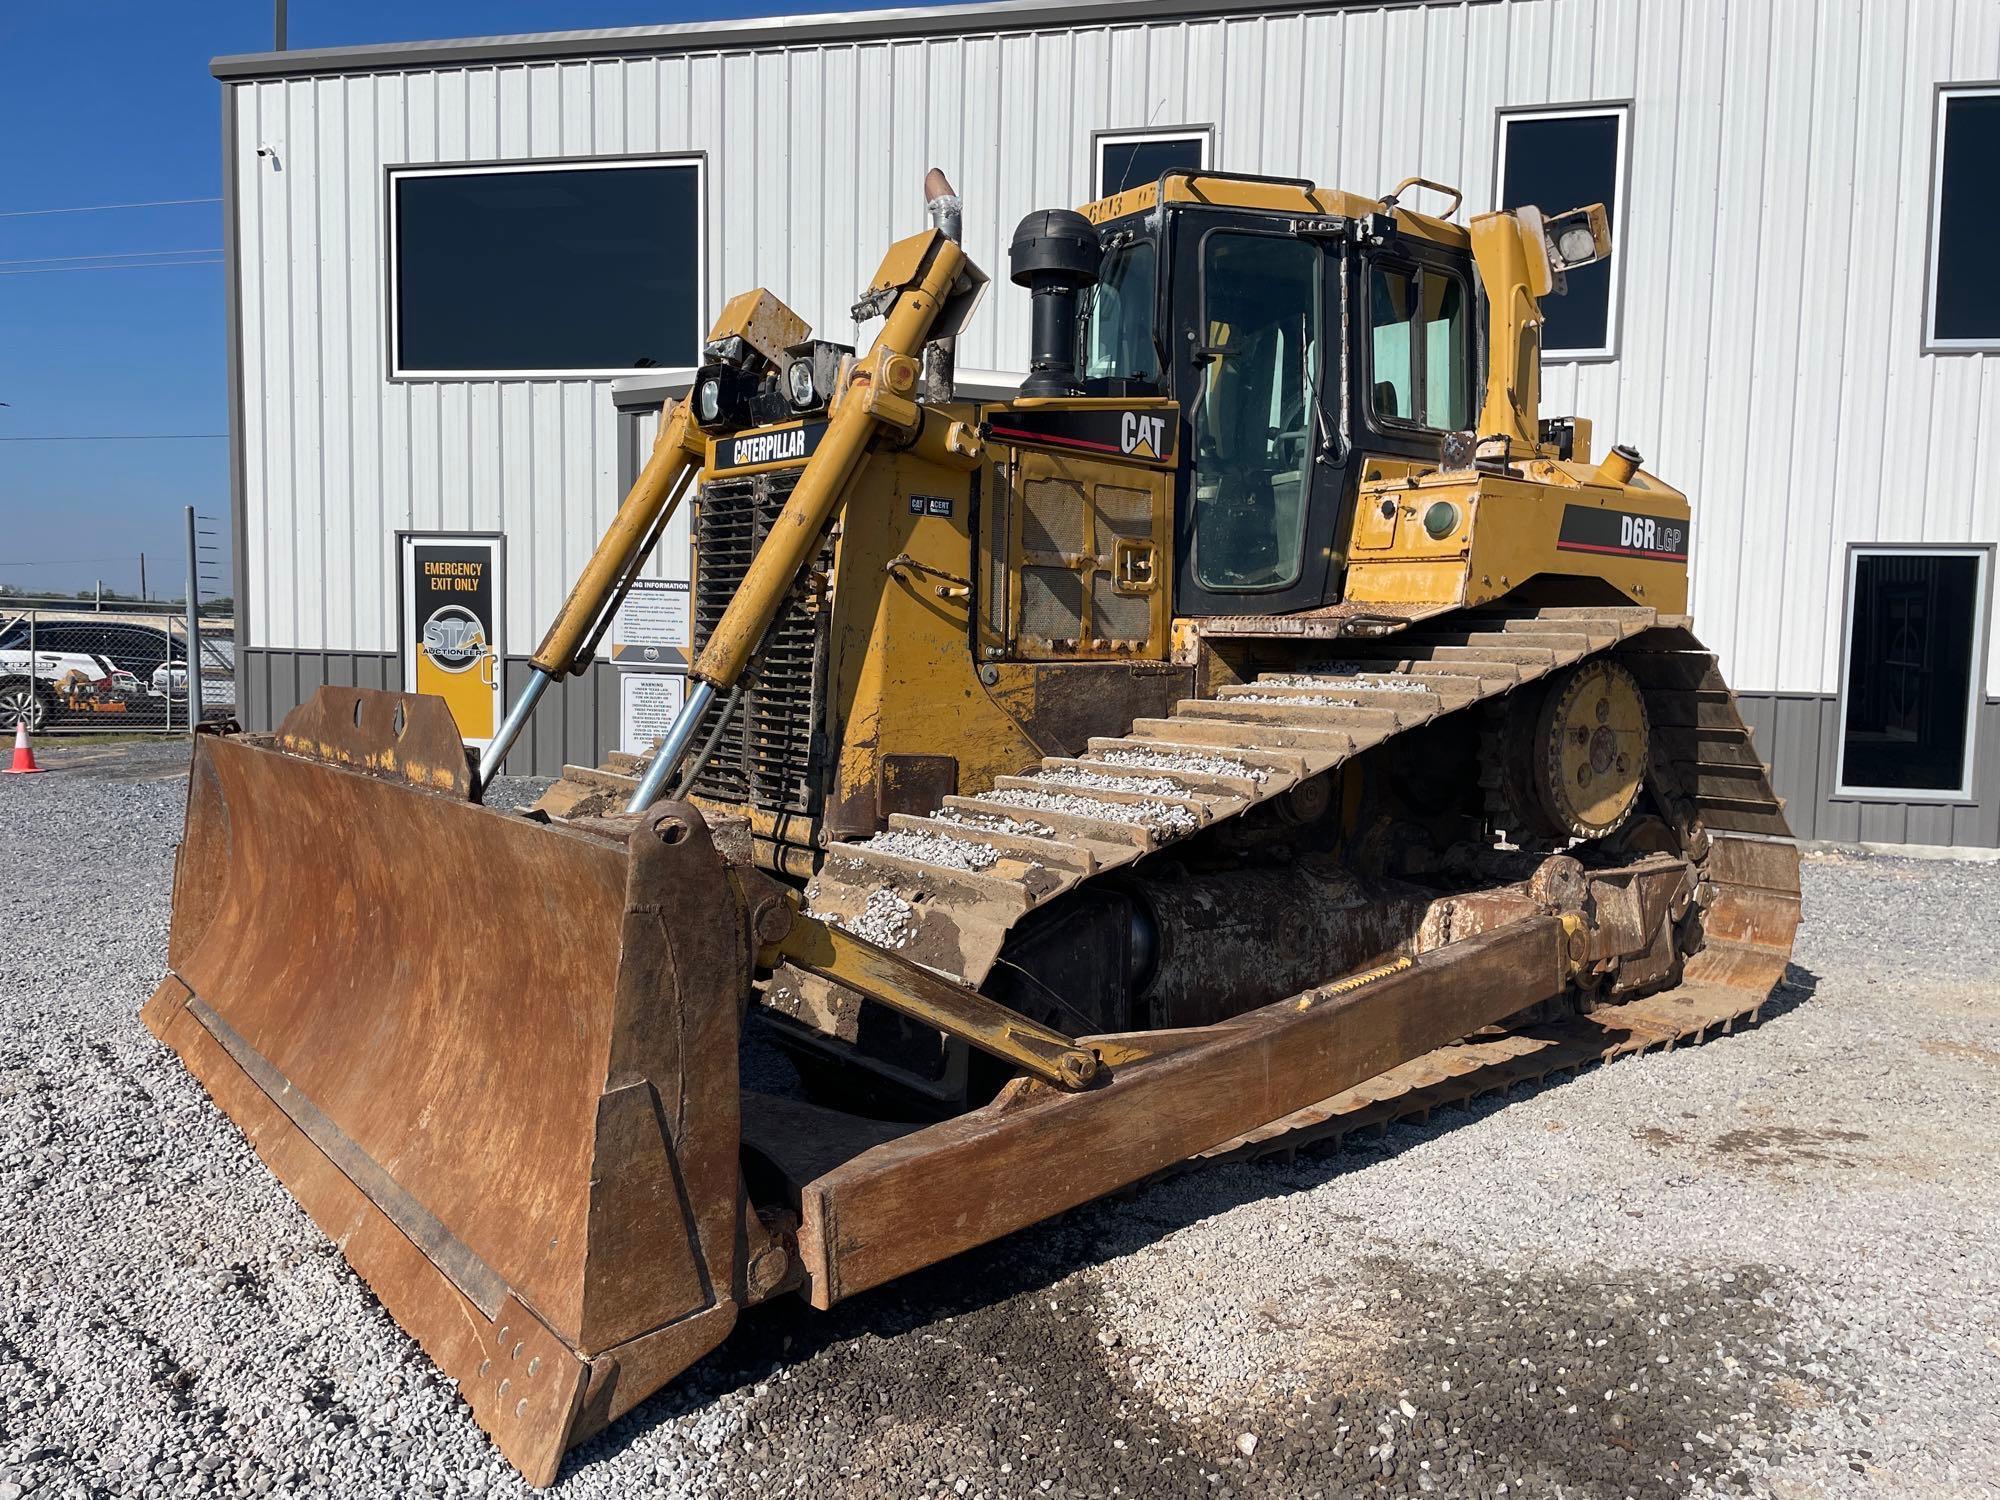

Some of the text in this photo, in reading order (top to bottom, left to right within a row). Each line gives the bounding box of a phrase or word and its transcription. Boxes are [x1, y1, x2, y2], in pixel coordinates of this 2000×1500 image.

[1121, 411, 1166, 459] CAT
[734, 430, 805, 464] CATERPILLAR
[911, 499, 924, 508] CAT
[930, 500, 950, 509] ACERT
[1620, 515, 1682, 552] D6R LGP
[424, 561, 483, 577] EMERGENCY
[431, 577, 479, 592] EXIT ONLY
[644, 581, 689, 590] INFORMATION
[423, 620, 487, 651] STA
[422, 648, 489, 656] AUCTIONEERS
